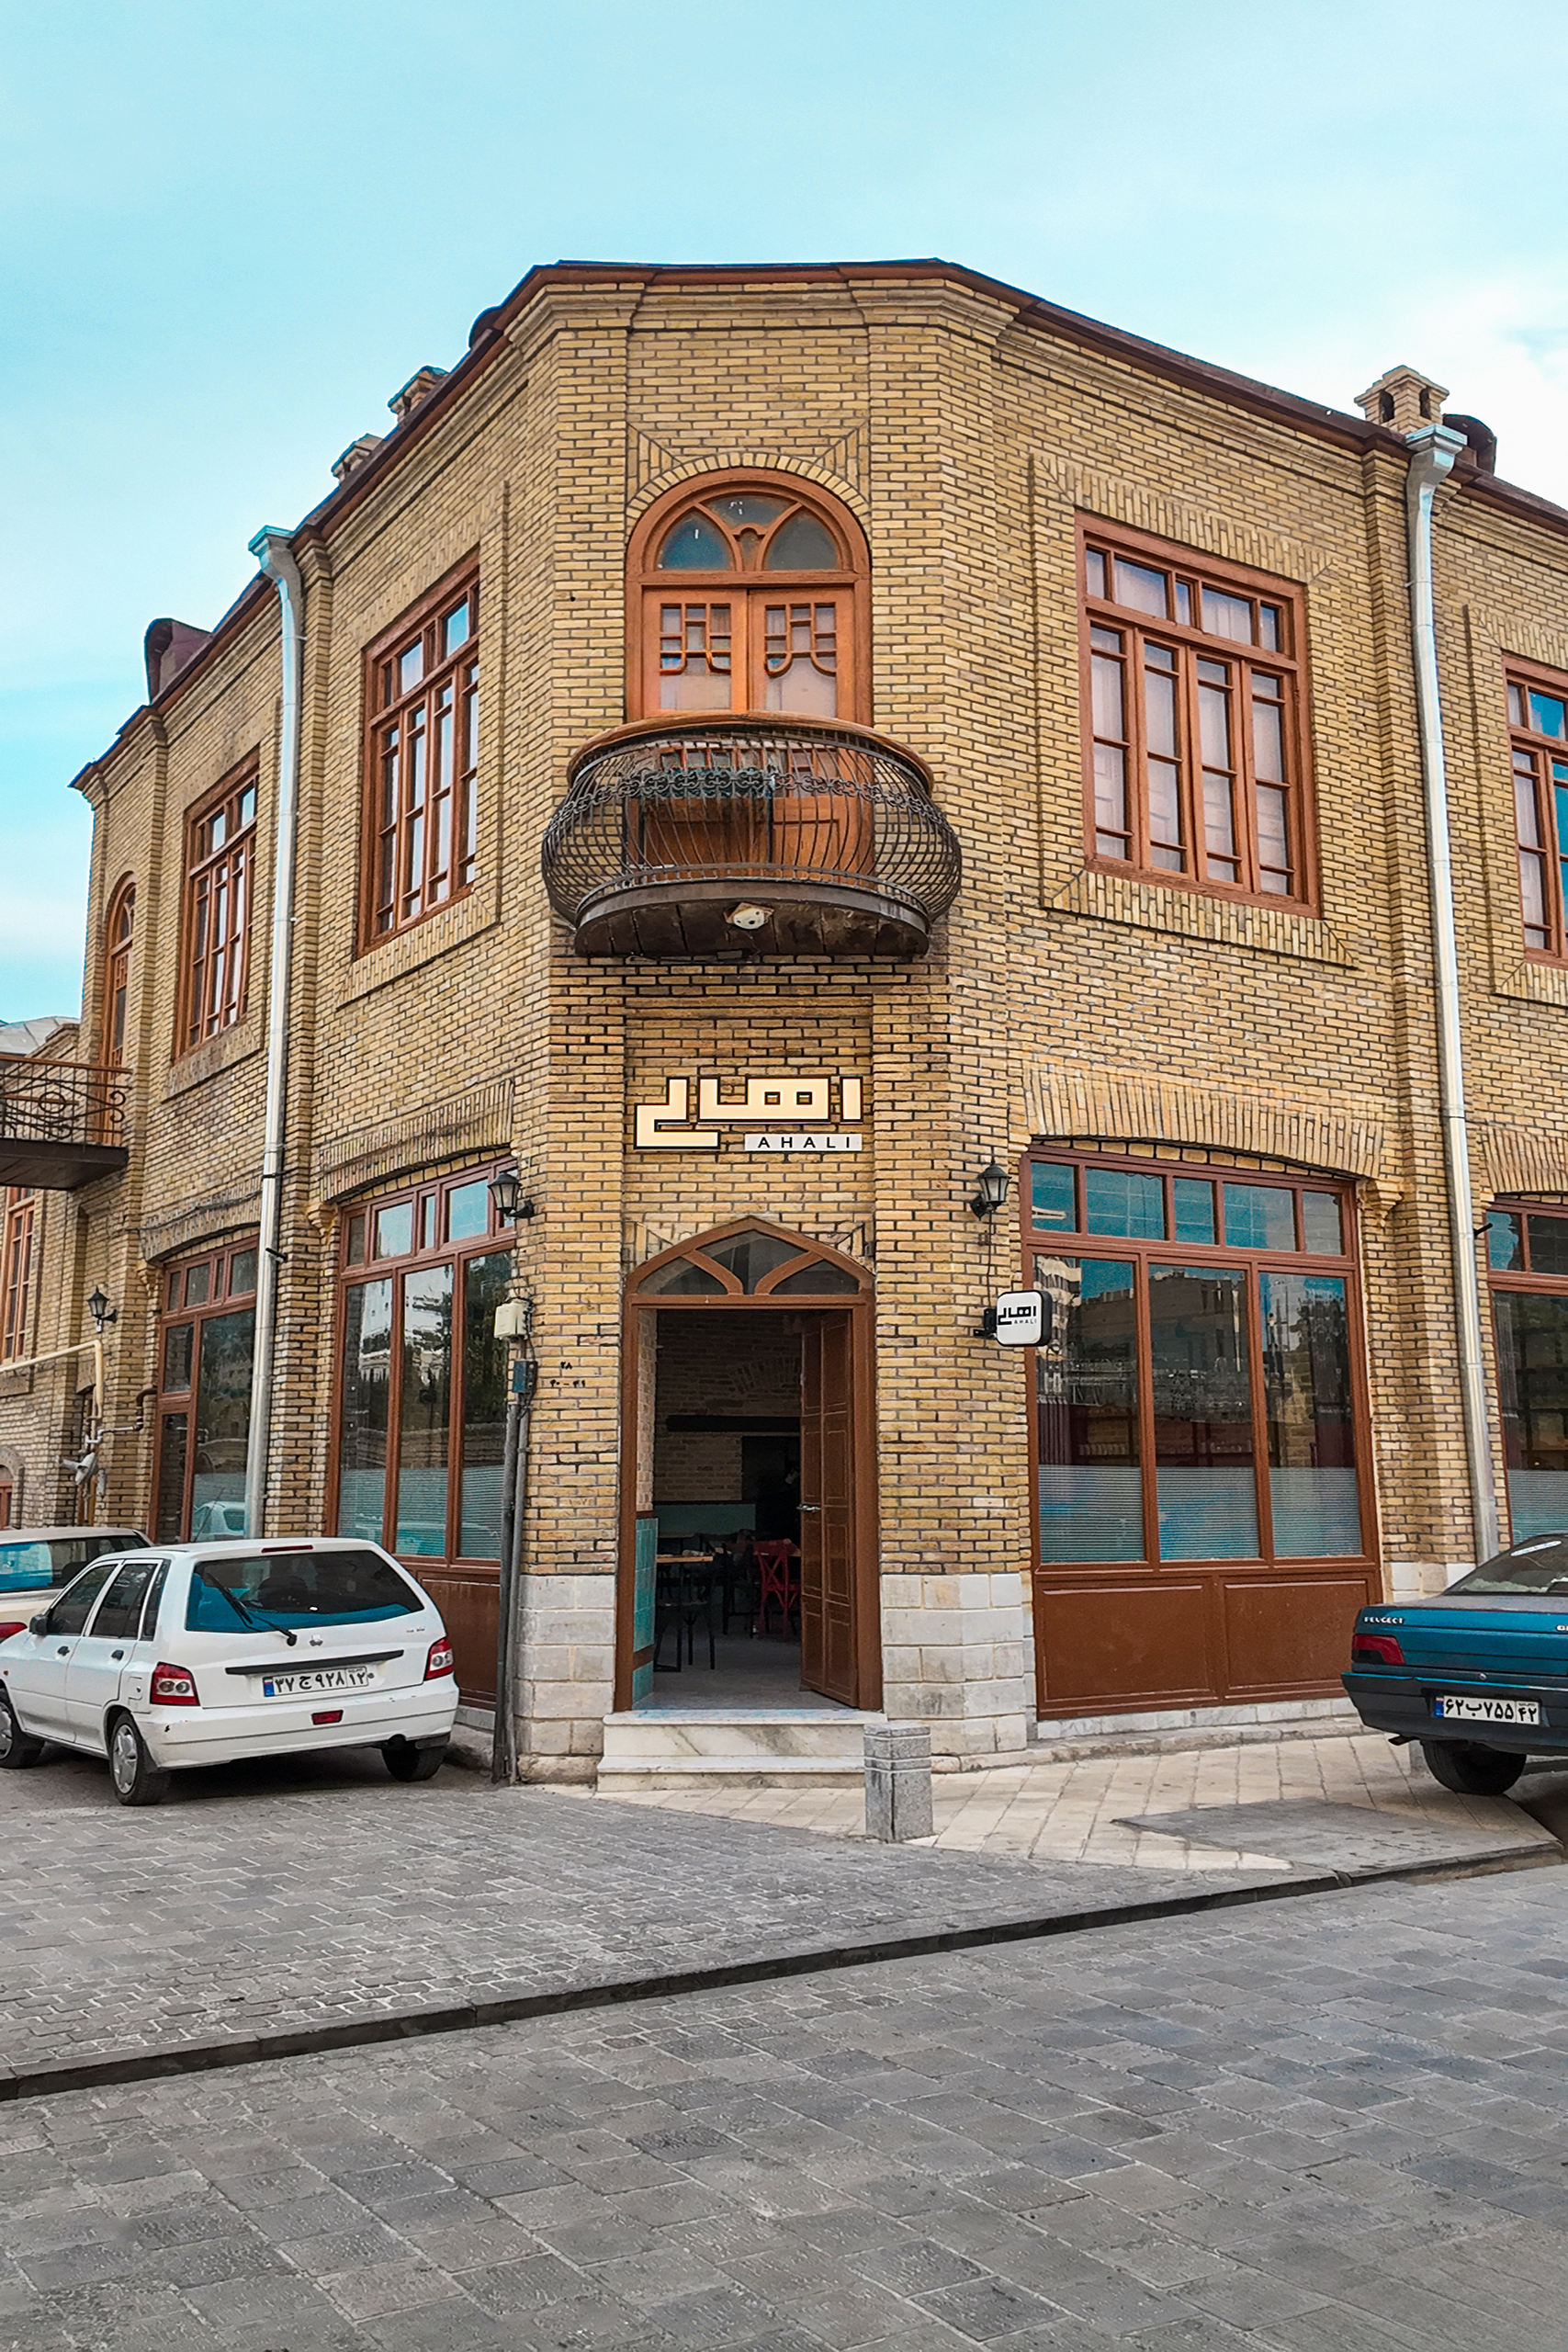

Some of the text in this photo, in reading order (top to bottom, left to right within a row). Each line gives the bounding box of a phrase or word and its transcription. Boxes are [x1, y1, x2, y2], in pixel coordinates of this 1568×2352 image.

[636, 1078, 862, 1148] اهالی
[757, 1136, 851, 1148] AHALI
[997, 1306, 1037, 1326] اهالی
